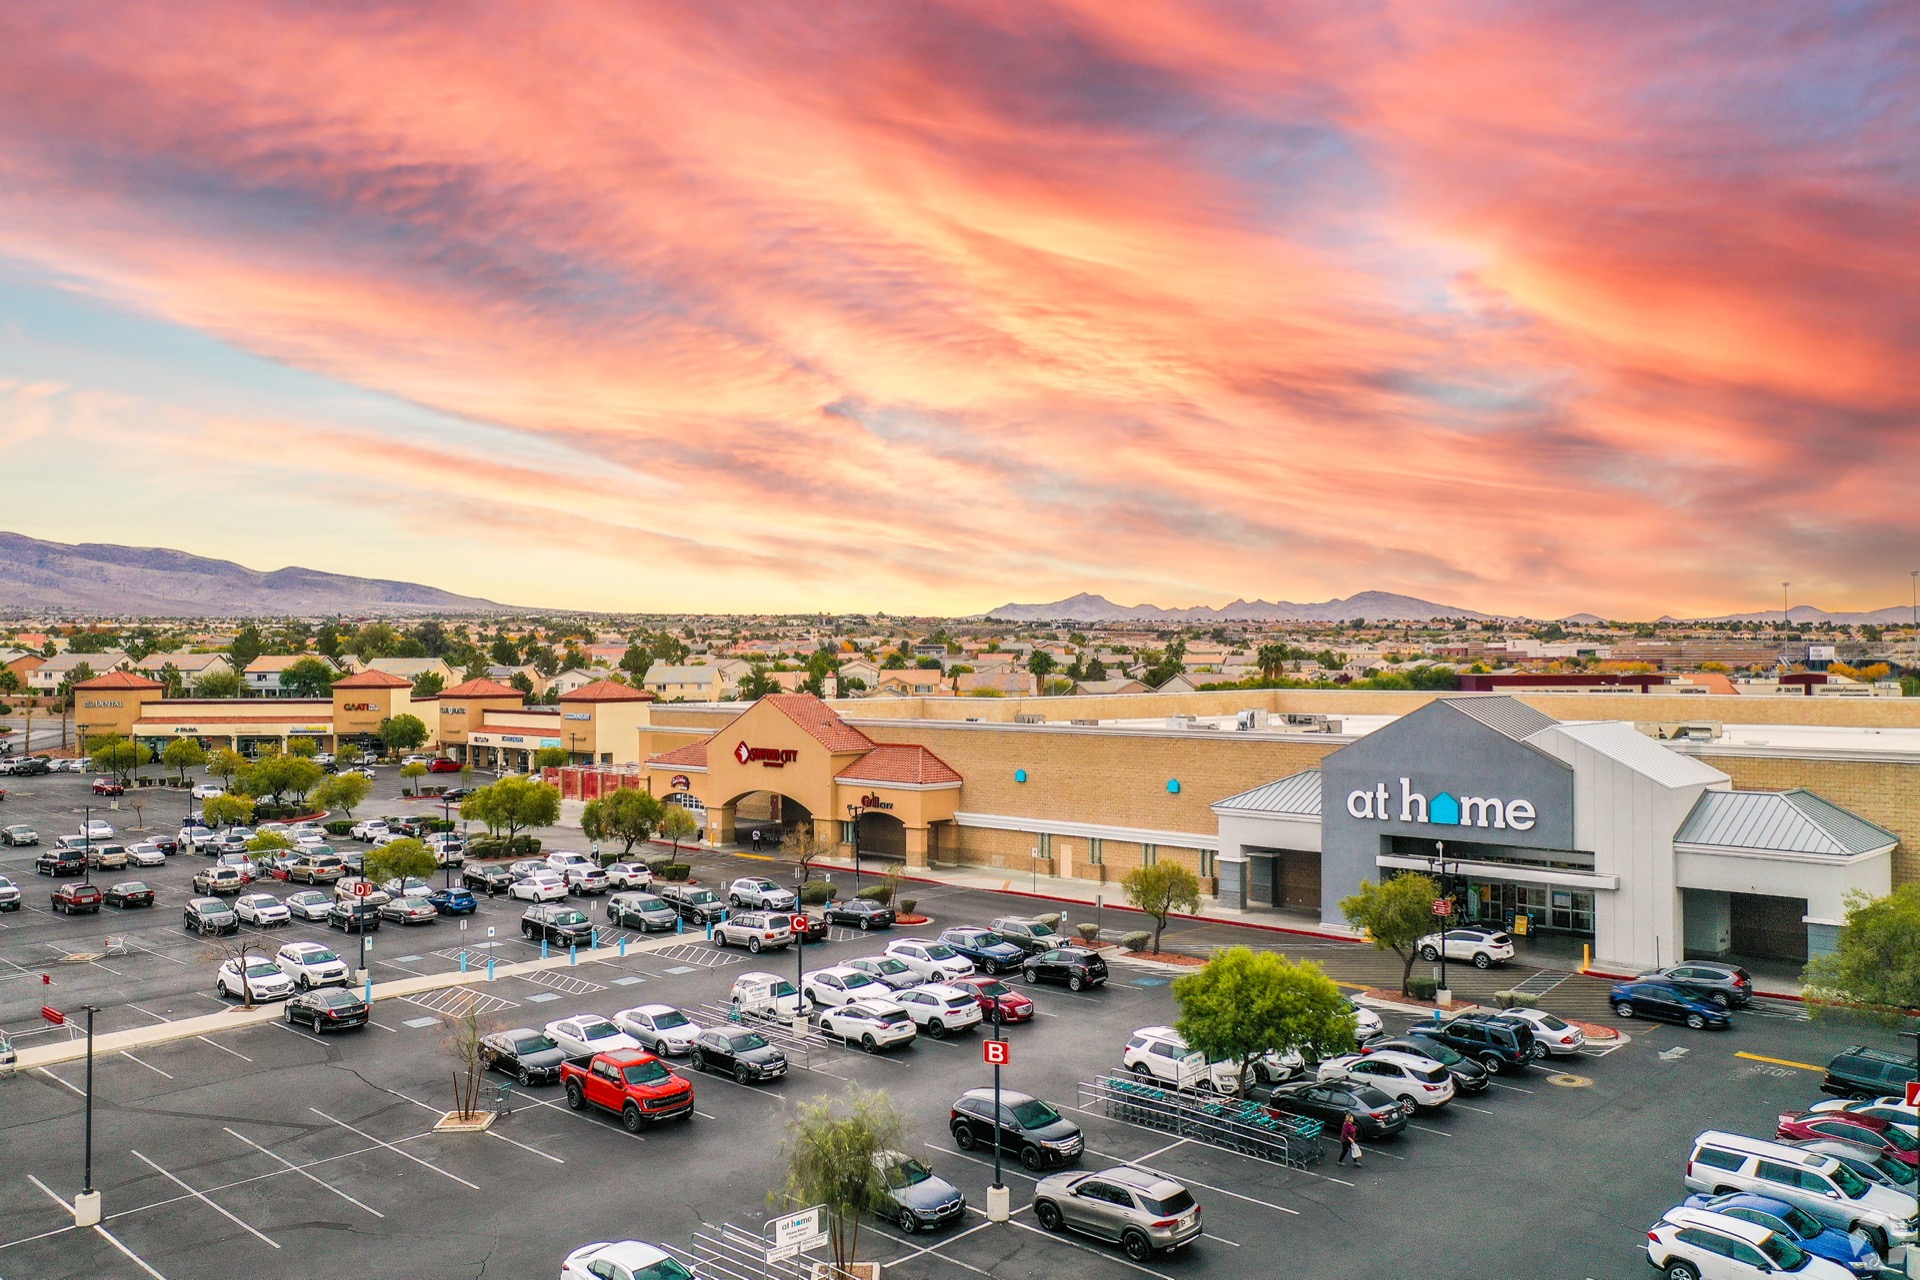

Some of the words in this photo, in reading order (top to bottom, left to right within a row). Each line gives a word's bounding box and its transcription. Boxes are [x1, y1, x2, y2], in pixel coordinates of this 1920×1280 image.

[95, 699, 124, 708] DENTAL
[780, 749, 798, 764] CITY
[860, 793, 880, 808] Grill
[1346, 782, 1390, 820] at
[356, 884, 364, 895] D
[793, 916, 806, 930] C
[988, 1043, 1004, 1062] B
[1749, 1064, 1798, 1078] STOP
[782, 1222, 790, 1230] at
